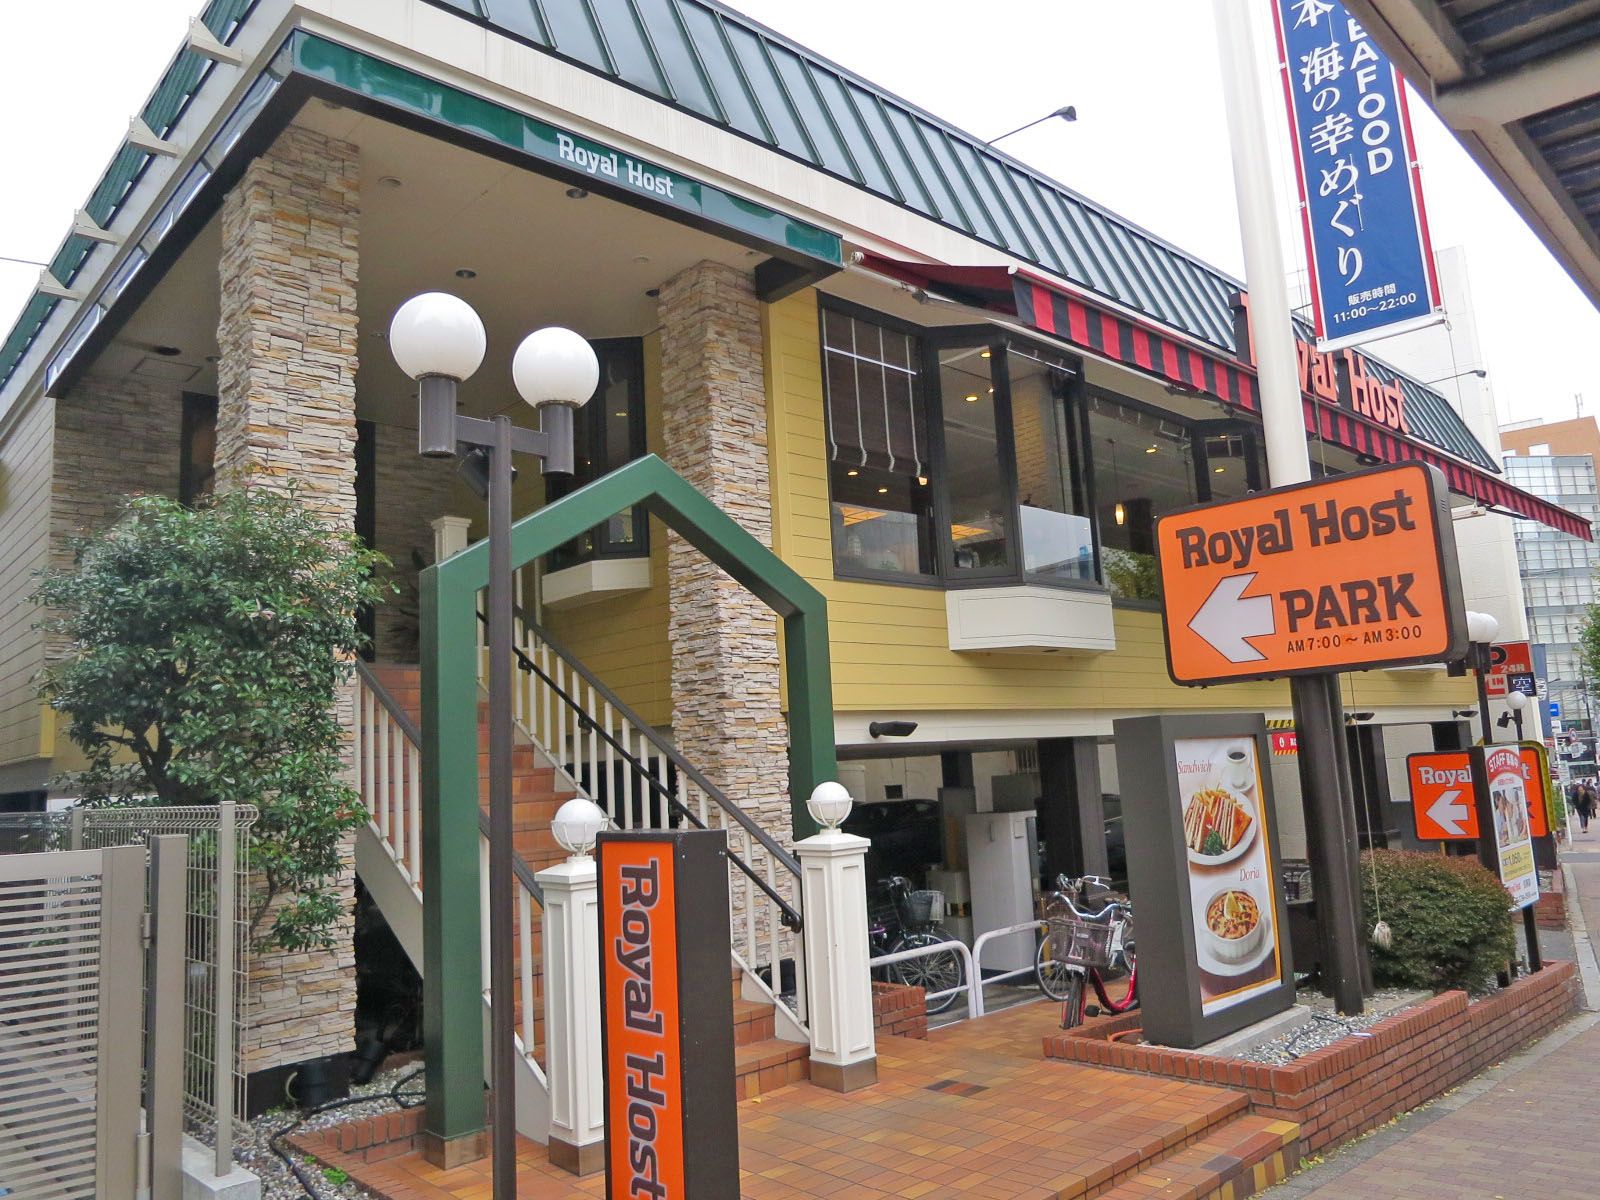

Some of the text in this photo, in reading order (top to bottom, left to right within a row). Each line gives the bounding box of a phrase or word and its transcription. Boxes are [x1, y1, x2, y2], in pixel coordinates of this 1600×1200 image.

[1344, 10, 1393, 175] EAFOOD
[556, 132, 674, 199] Royal Host
[1348, 283, 1396, 306] 販売時間
[1344, 348, 1409, 434] Host
[1176, 489, 1416, 569] Royal Host
[1280, 572, 1421, 632] PARK
[1178, 760, 1212, 774] Sandwich
[1418, 764, 1472, 787] Royal
[1239, 867, 1260, 882] Doria
[614, 857, 667, 1200] Royal Host
